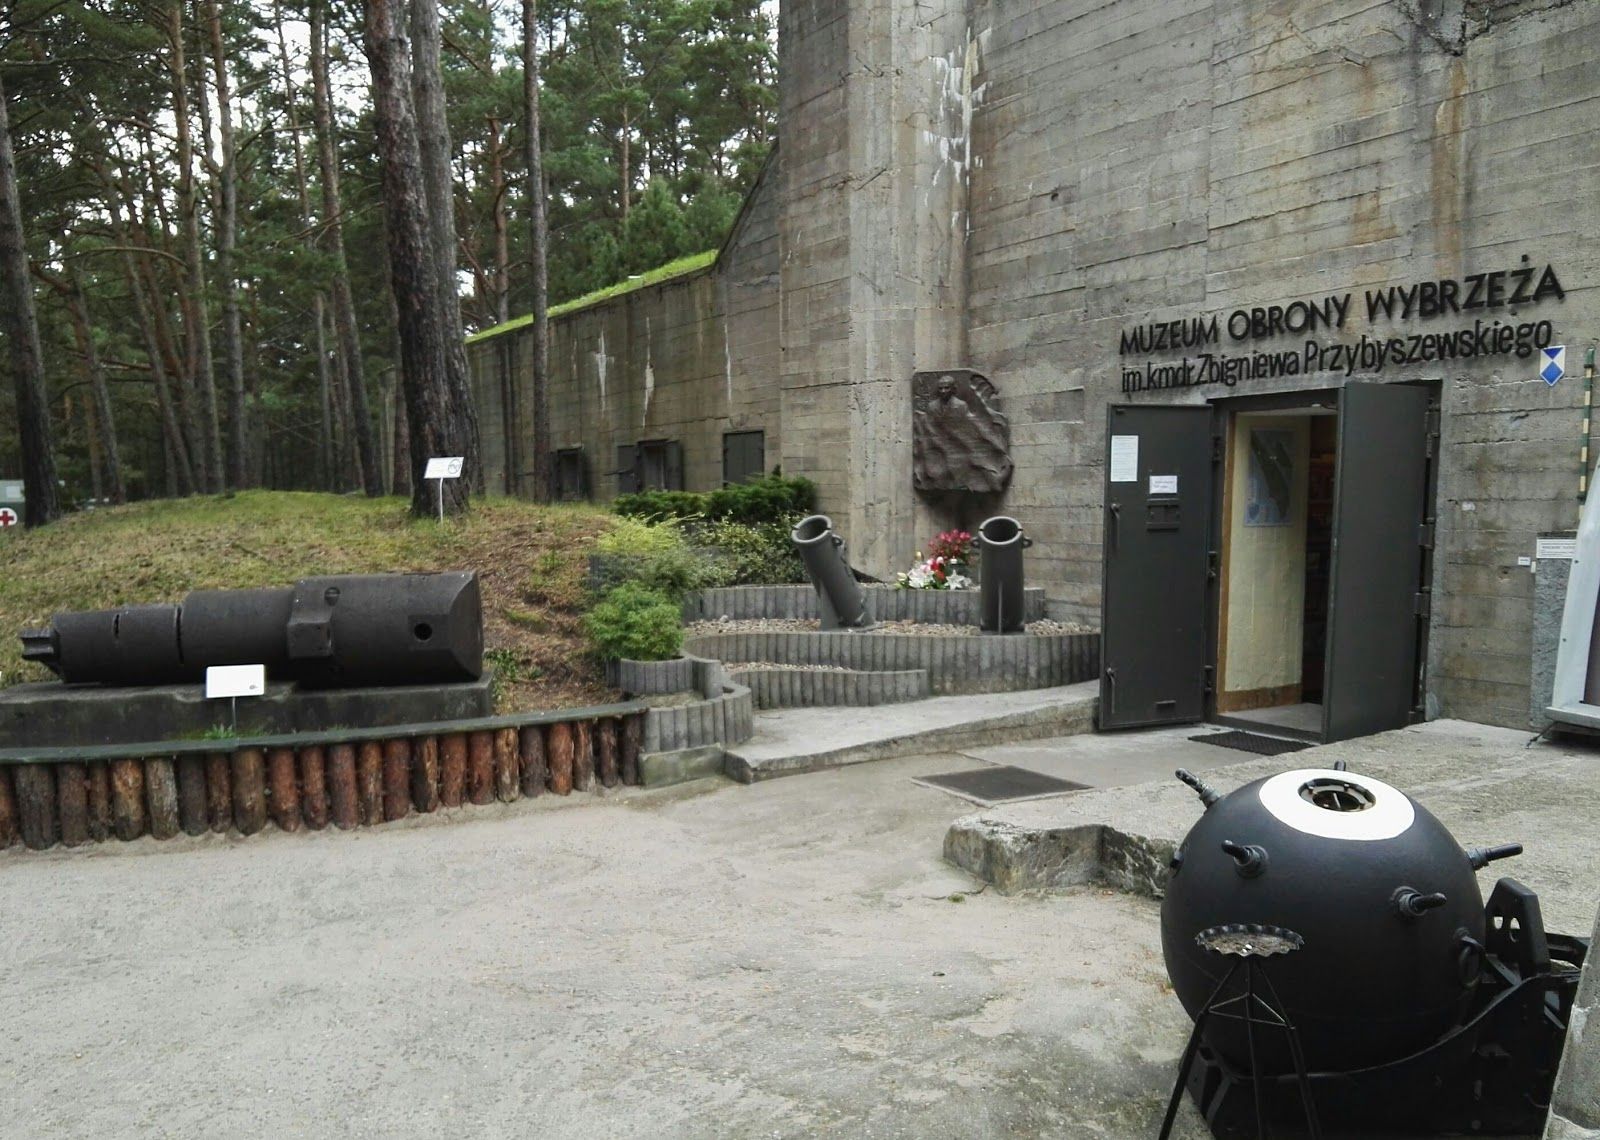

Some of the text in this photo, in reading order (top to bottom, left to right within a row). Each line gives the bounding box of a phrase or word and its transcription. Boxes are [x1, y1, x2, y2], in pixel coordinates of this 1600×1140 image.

[1119, 254, 1566, 355] MUZEUM OBRONY WYBRZEŻA
[1303, 319, 1553, 377] Przybyszewskiego
